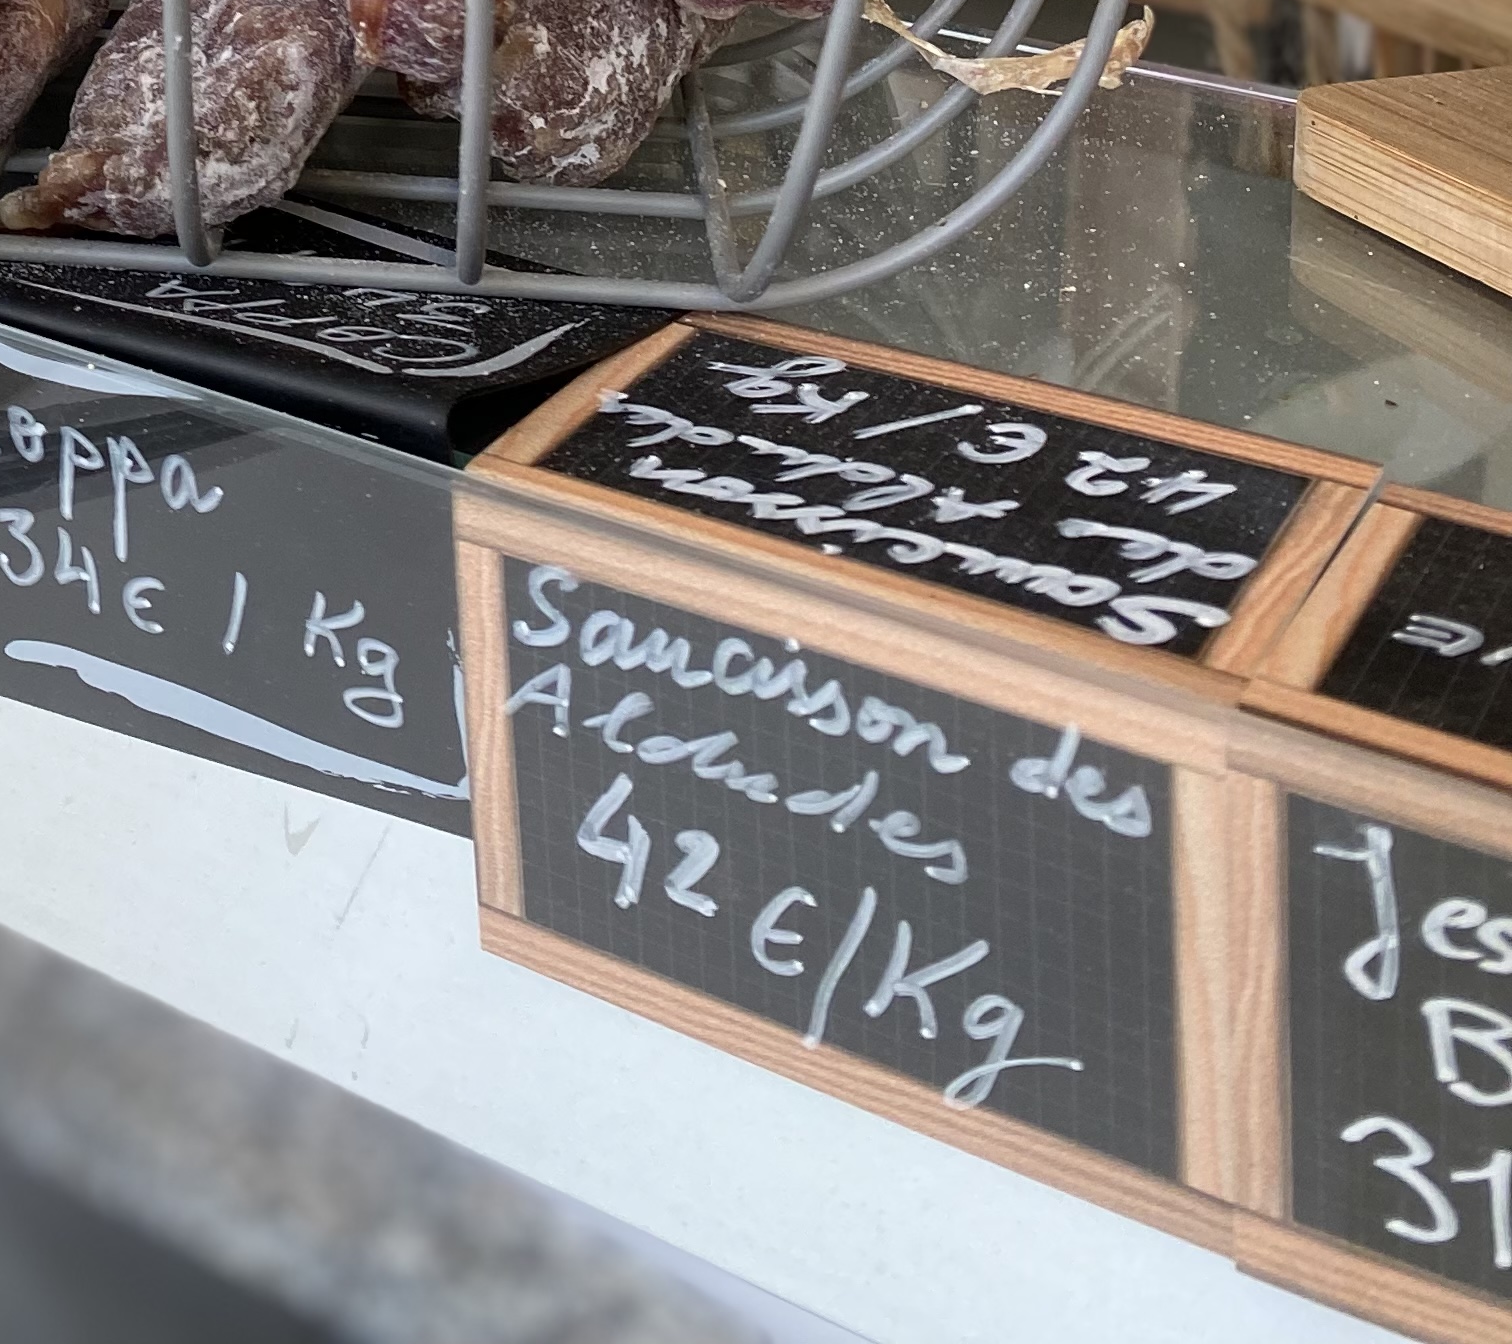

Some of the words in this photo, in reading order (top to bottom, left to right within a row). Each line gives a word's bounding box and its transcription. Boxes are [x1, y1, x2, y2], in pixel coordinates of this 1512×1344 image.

[1064, 450, 1238, 516] 42
[512, 564, 972, 775] Saucisson
[1010, 722, 1153, 838] des
[576, 772, 720, 918] 42
